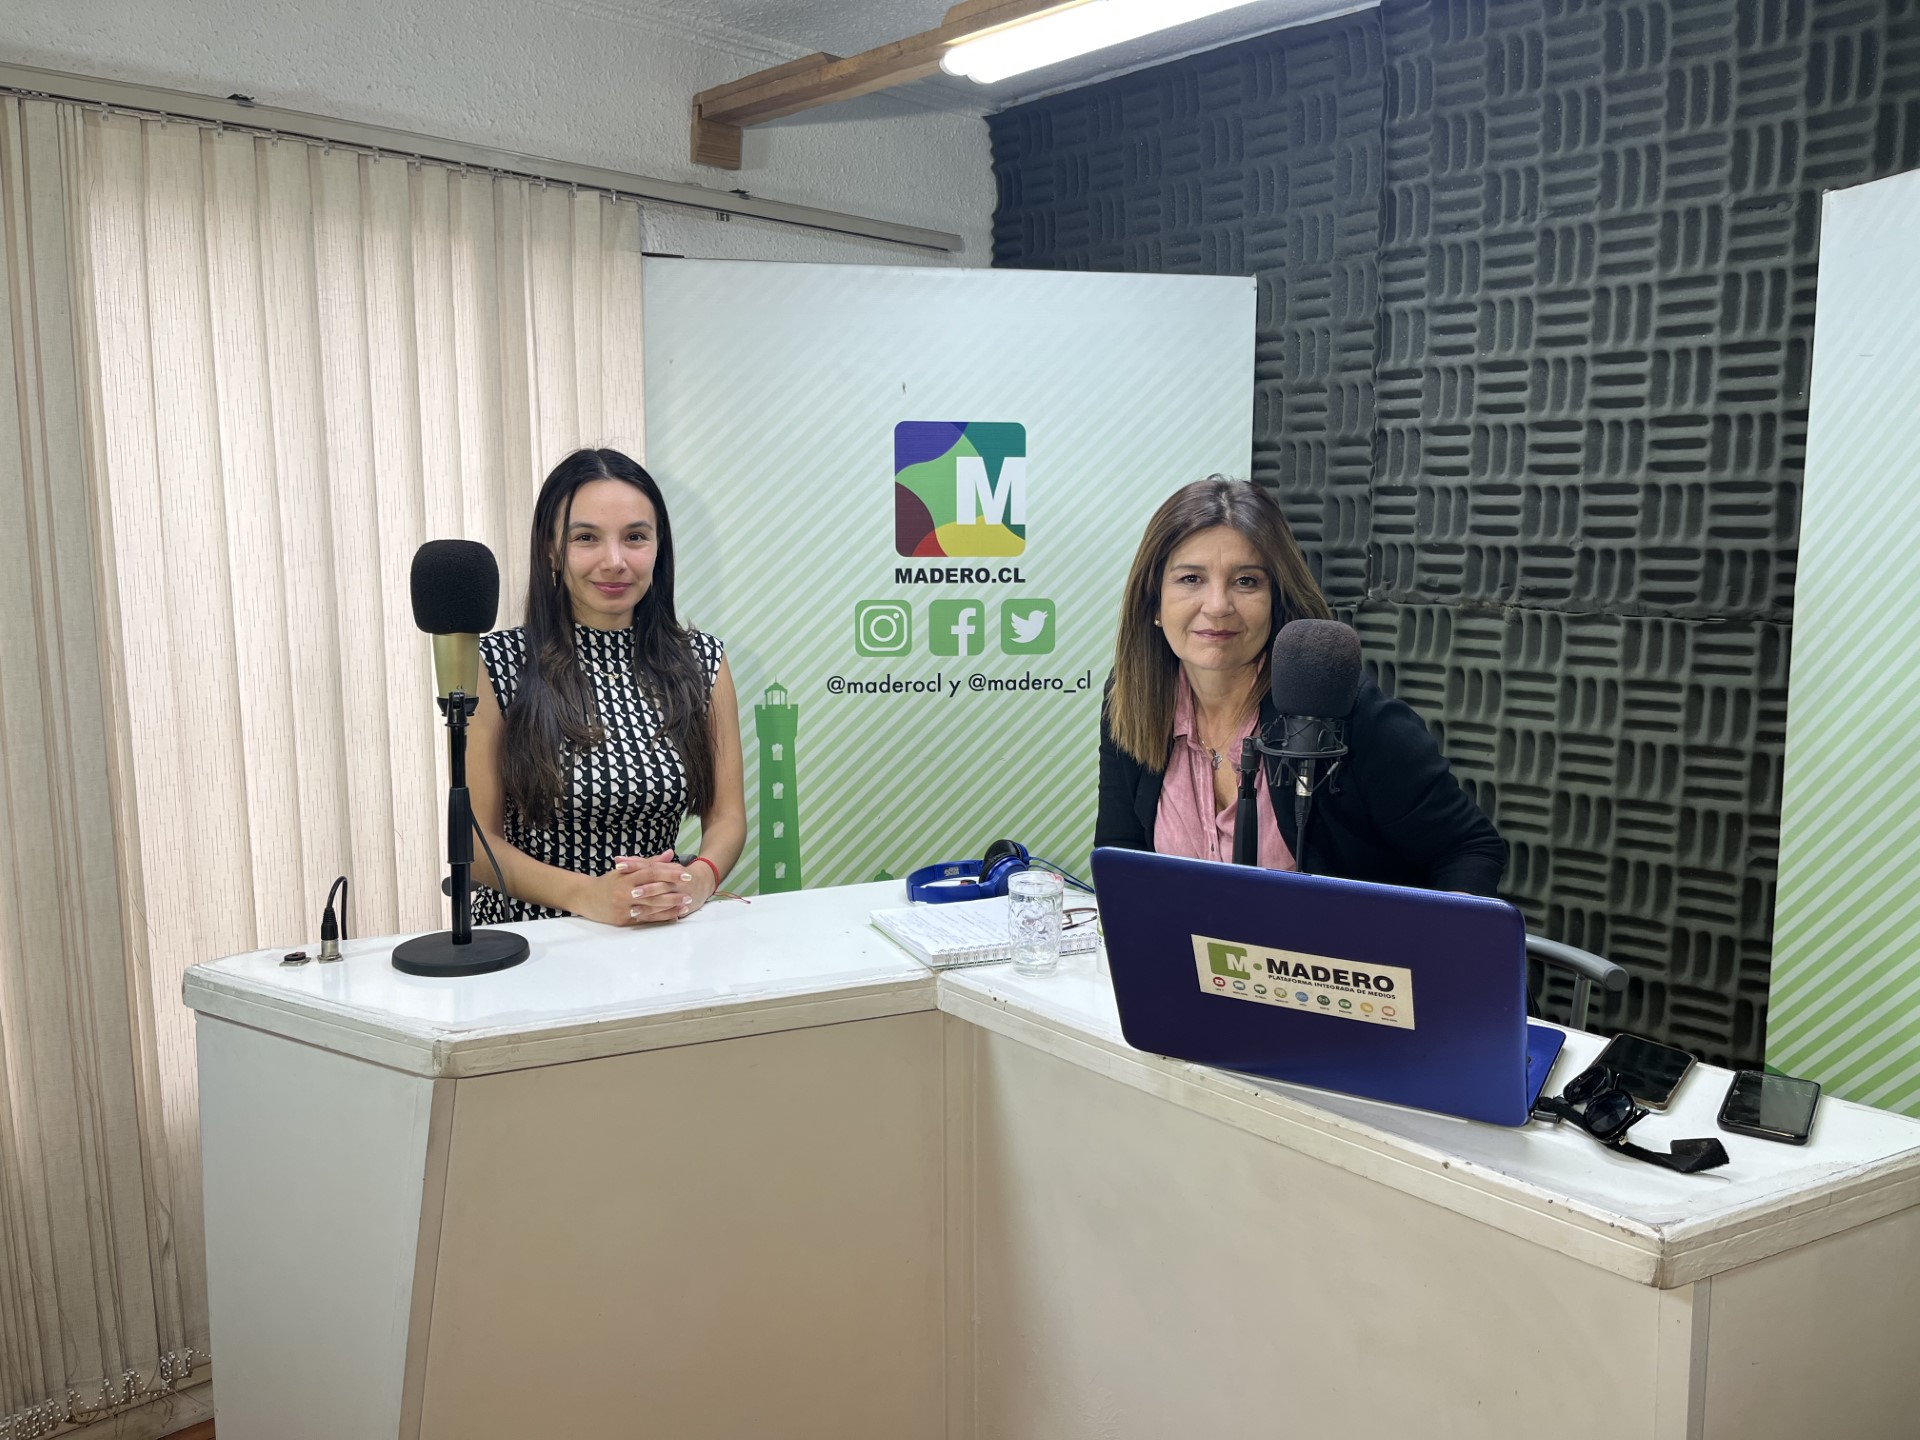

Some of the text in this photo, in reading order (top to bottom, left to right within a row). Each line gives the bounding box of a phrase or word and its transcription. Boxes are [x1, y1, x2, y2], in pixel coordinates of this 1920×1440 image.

[956, 456, 1026, 525] M
[895, 567, 1026, 584] MADERO.CL
[826, 670, 1091, 698] @maderocl y @madero_cl
[1225, 953, 1249, 973] M
[1265, 958, 1395, 992] MADERO
[1268, 975, 1312, 986] PLATAFORMA
[1314, 983, 1355, 993] INTEGRADA
[1368, 991, 1396, 1000] MEDIOS
